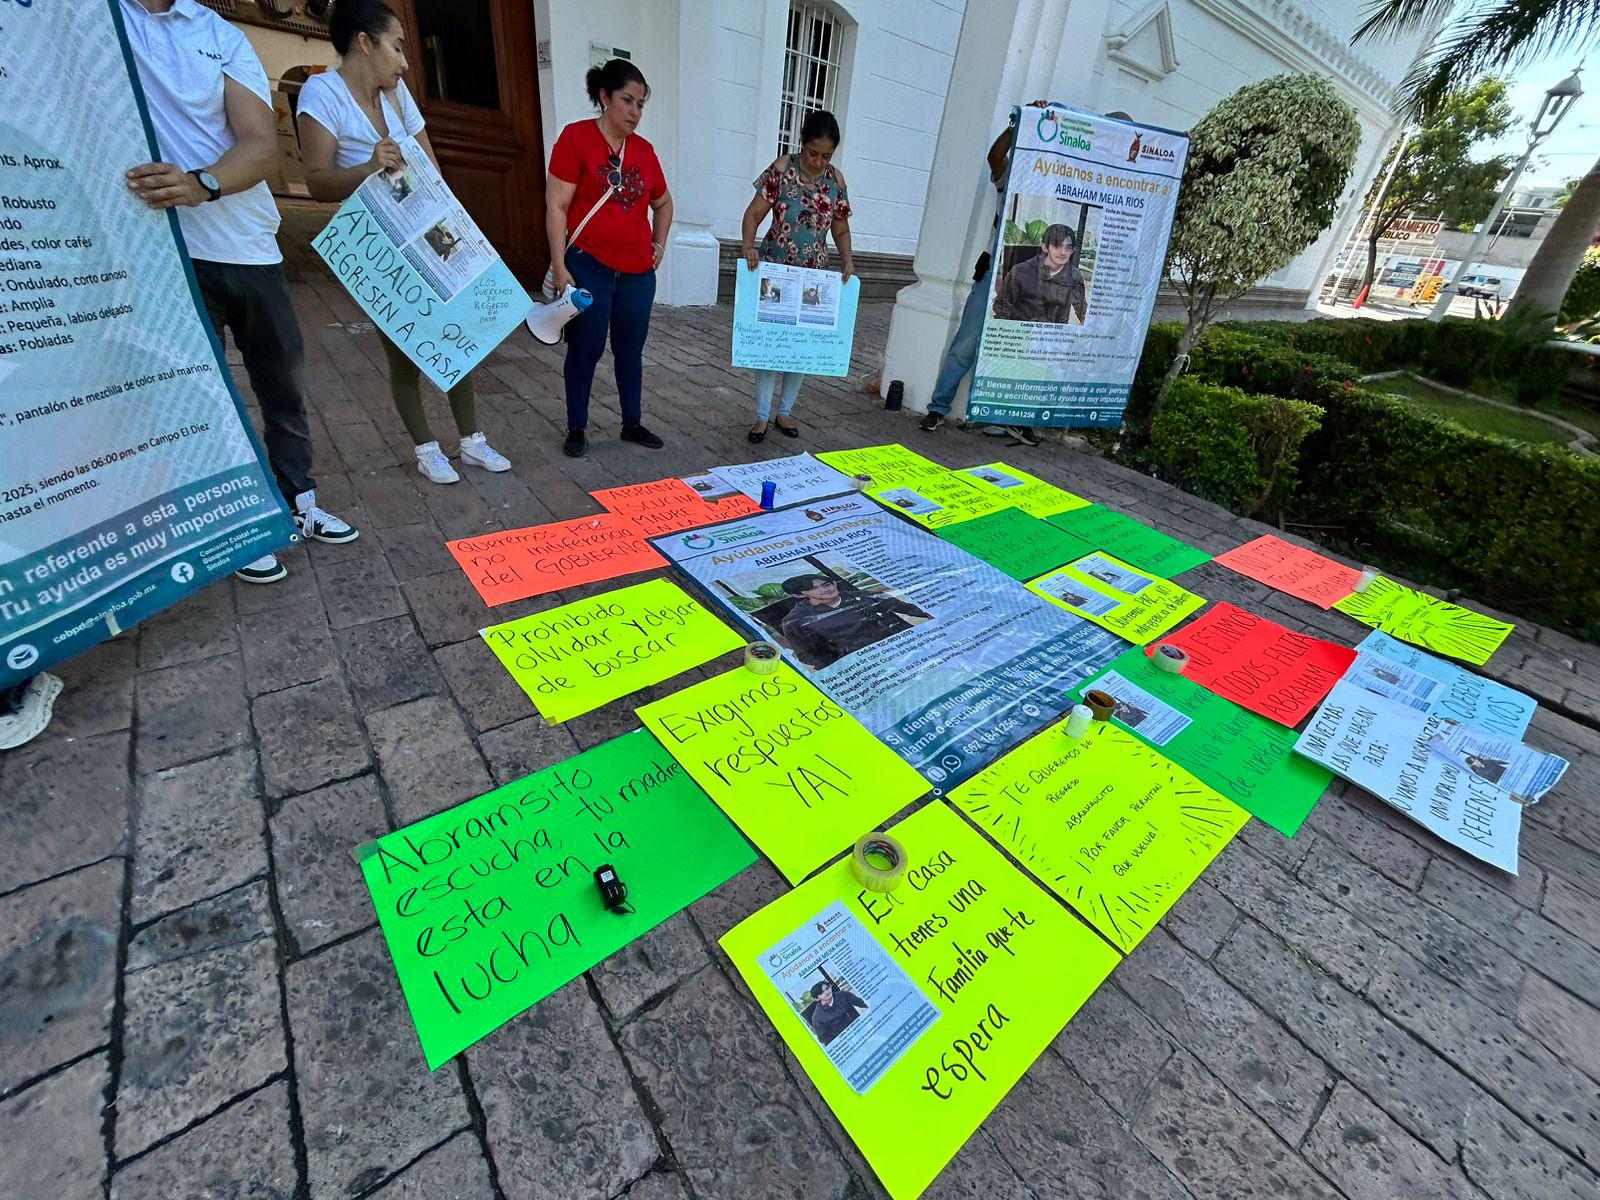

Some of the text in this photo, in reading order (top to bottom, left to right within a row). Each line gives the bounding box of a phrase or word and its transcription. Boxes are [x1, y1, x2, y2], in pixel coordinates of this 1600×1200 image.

[24, 154, 64, 170] Aprox.
[1059, 131, 1091, 151] Sinaloa
[1141, 145, 1175, 158] SINALOA
[1033, 157, 1169, 195] Ayúdanos a encontrar a
[1055, 184, 1145, 208] ABRAHAM MEJIA RIOS
[2, 196, 56, 209] Robusto
[31, 236, 92, 249] color cafés
[6, 270, 127, 291] Ondulado, corto canoso
[479, 279, 496, 287] LOS
[7, 303, 133, 332] Pequeña, labios delgados
[11, 297, 55, 312] Amplia
[318, 226, 400, 322] REGRESEN
[395, 321, 416, 343] A
[416, 341, 461, 384] CASA
[19, 333, 74, 351] Pobladas
[441, 323, 479, 357] QUE
[15, 401, 69, 424] pantalón
[70, 397, 84, 408] de
[85, 386, 123, 404] mezclilla
[124, 381, 135, 391] de
[135, 374, 156, 387] color
[158, 370, 176, 381] azul
[177, 362, 212, 376] marino,
[987, 381, 1012, 390] tienes
[1014, 383, 1058, 392] información
[1060, 385, 1087, 393] referente
[3, 422, 210, 502] 2025, siendo las 06:00 pm, en Campo El Diez
[33, 498, 45, 511] el
[46, 479, 100, 505] momento.
[821, 501, 859, 514] SINALOA
[24, 474, 258, 584] referente a esta persona,
[631, 507, 693, 526] MADRE
[644, 523, 672, 535] EN
[718, 529, 766, 544] Sinaloa
[37, 565, 103, 606] ayuda
[105, 553, 128, 571] es
[130, 531, 167, 560] muy
[171, 493, 265, 538] importante.
[457, 529, 556, 554] Queremos
[471, 553, 506, 568] no
[711, 516, 884, 566] Ayúdanos a encontrar a
[754, 546, 814, 567] ABRAHAM
[848, 528, 873, 540] RIOS
[481, 540, 651, 587] del GOBIERNO
[490, 602, 626, 648] Prohibido
[515, 627, 612, 670] olvidar
[643, 601, 700, 627] dejar
[1190, 608, 1262, 655] ESTAMOS
[537, 632, 678, 695] de buscar
[1211, 659, 1280, 701] TODOS
[1263, 632, 1319, 670] FALTA
[658, 675, 798, 744] Exigimos
[899, 731, 937, 758] llama
[936, 726, 945, 735] o
[1003, 682, 1015, 694] Tu
[1017, 668, 1042, 689] ayuda
[1042, 661, 1053, 673] es
[1052, 652, 1072, 668] muy
[902, 709, 941, 735] tienes
[941, 674, 998, 712] información
[1001, 655, 1040, 680] referente
[1041, 649, 1048, 657] a
[1259, 662, 1337, 721] ABRAHAM
[703, 699, 844, 787] respuestas
[980, 717, 1018, 744] 1841256
[573, 796, 616, 822] tu
[619, 760, 683, 804] madre
[1000, 737, 1095, 806] TE QUEREMOS DE
[1045, 778, 1081, 804] REGRESO
[376, 768, 594, 884] Abramsito
[1102, 816, 1131, 842] FAVOR
[416, 830, 632, 957] esta en la
[889, 879, 988, 958] tienes una
[433, 912, 584, 1015] lucha
[782, 954, 814, 981] Ayúdanos
[818, 926, 848, 952] encontrar
[782, 945, 803, 962] Sinaloa
[927, 907, 1036, 1005] Familia que te
[921, 1003, 1011, 1101] espera
